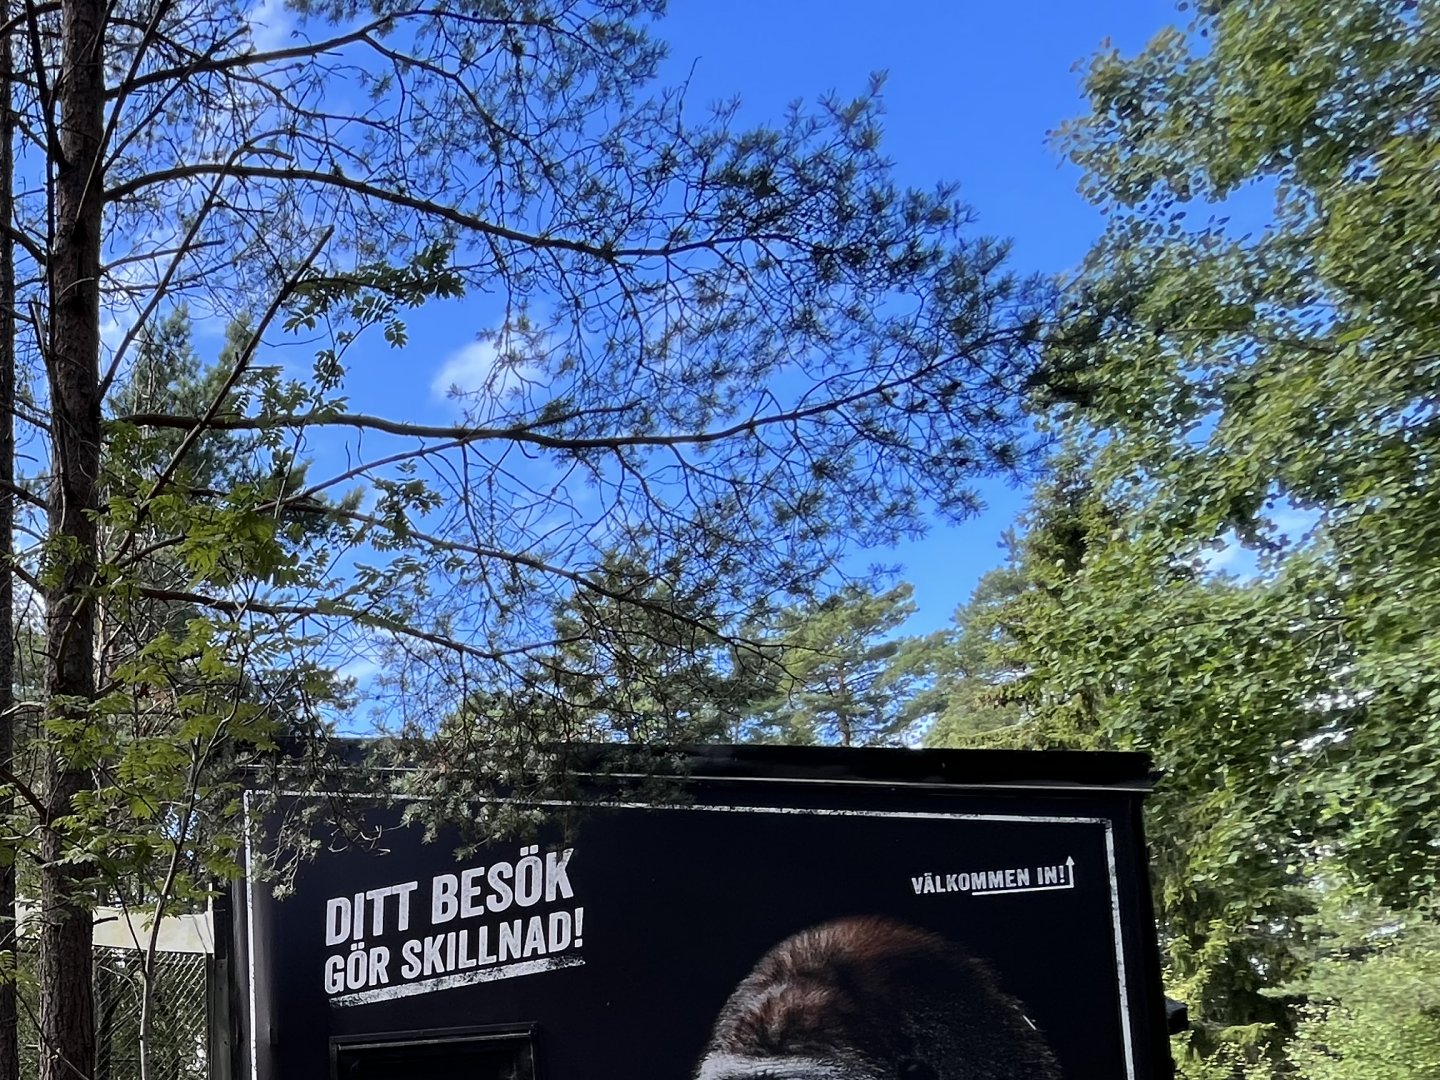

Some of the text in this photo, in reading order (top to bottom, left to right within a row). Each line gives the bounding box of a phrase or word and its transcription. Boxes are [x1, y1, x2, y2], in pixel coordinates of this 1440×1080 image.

[325, 844, 574, 946] DITT BESÖK
[911, 865, 1065, 894] VÄLKOMMEN IN!
[324, 907, 584, 995] GÖR SKILLNAD!
